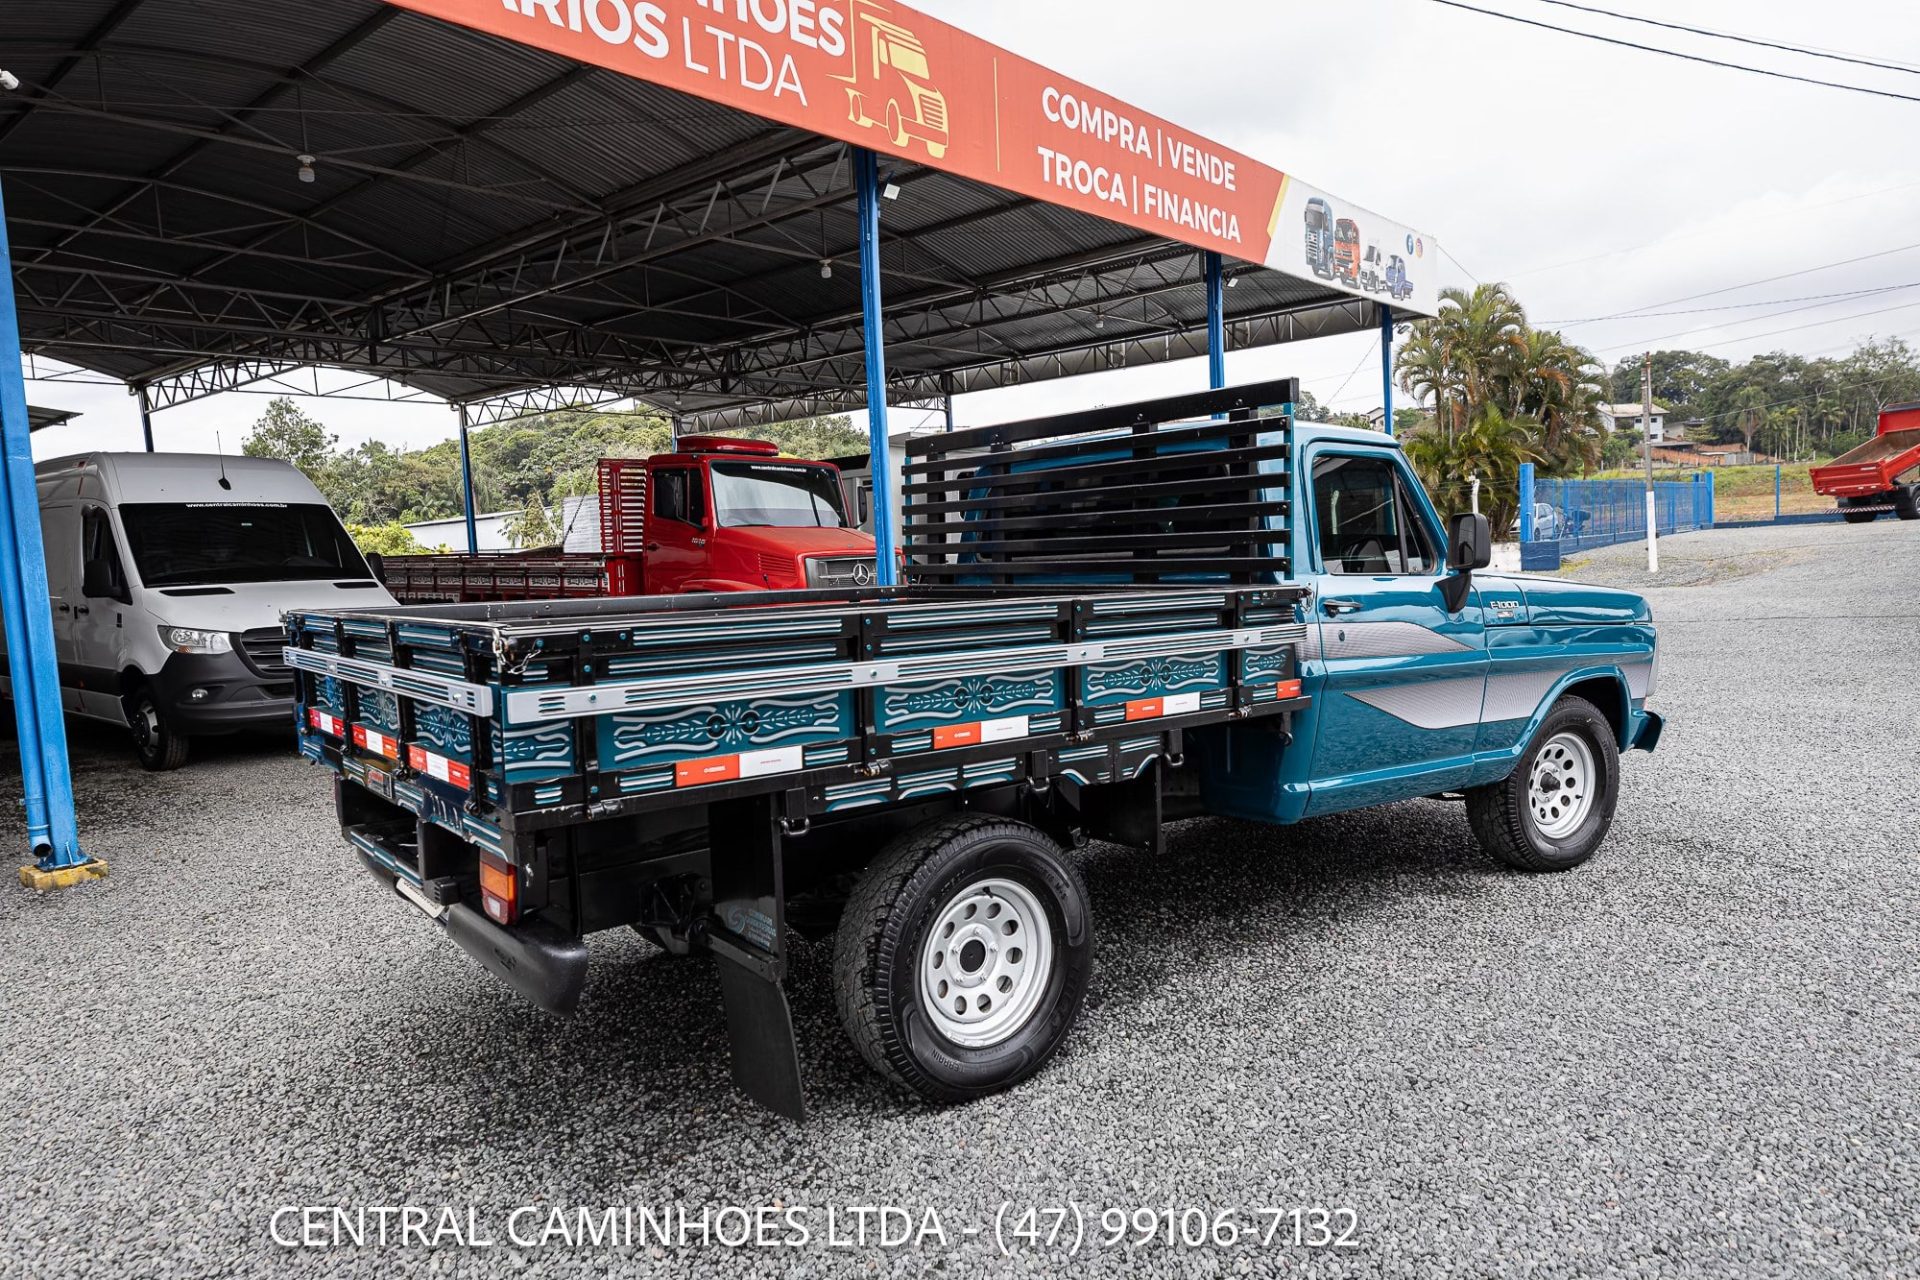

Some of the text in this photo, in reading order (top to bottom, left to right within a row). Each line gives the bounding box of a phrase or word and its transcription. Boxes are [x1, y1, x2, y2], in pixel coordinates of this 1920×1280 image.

[682, 16, 808, 107] LTDA
[1041, 86, 1153, 160] COMPRA
[1167, 136, 1236, 192] VENDE
[1037, 145, 1128, 209] TROCA
[1143, 183, 1241, 244] FINANCIA
